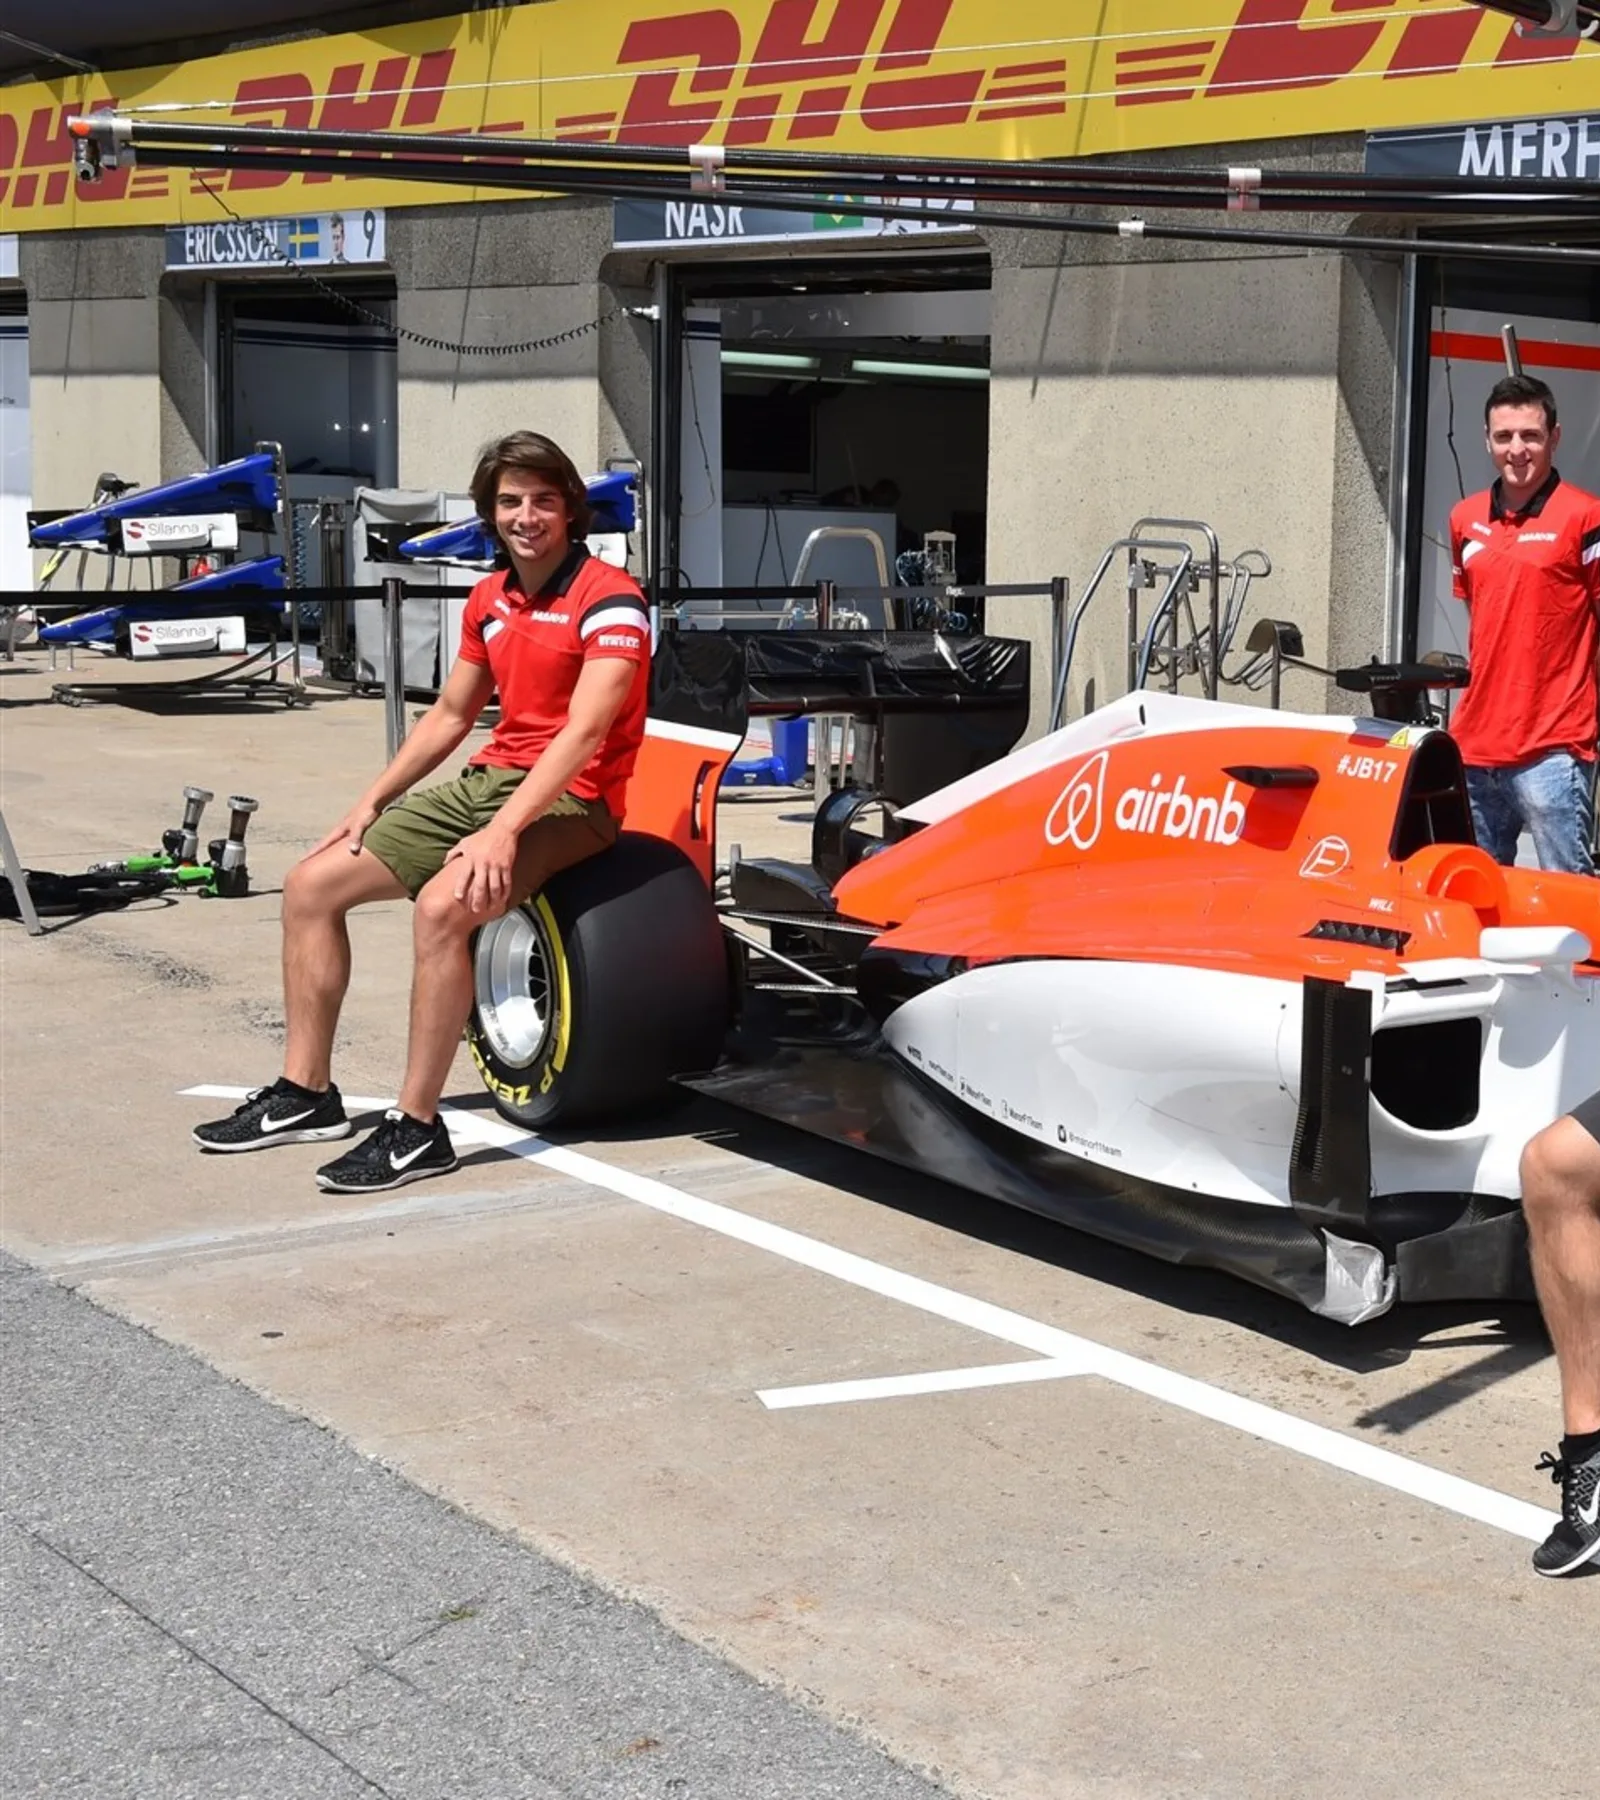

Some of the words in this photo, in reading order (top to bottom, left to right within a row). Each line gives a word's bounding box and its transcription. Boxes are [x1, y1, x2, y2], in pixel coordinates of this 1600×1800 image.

[616, 0, 985, 146] DHL
[227, 48, 473, 191] DHL
[185, 220, 279, 263] ERICSSON
[363, 210, 376, 259] 9
[147, 523, 200, 536] Silanna
[156, 626, 206, 639] Silanna
[1336, 754, 1398, 783] #JB17
[1115, 772, 1246, 846] airbnb
[1368, 897, 1394, 912] WILL
